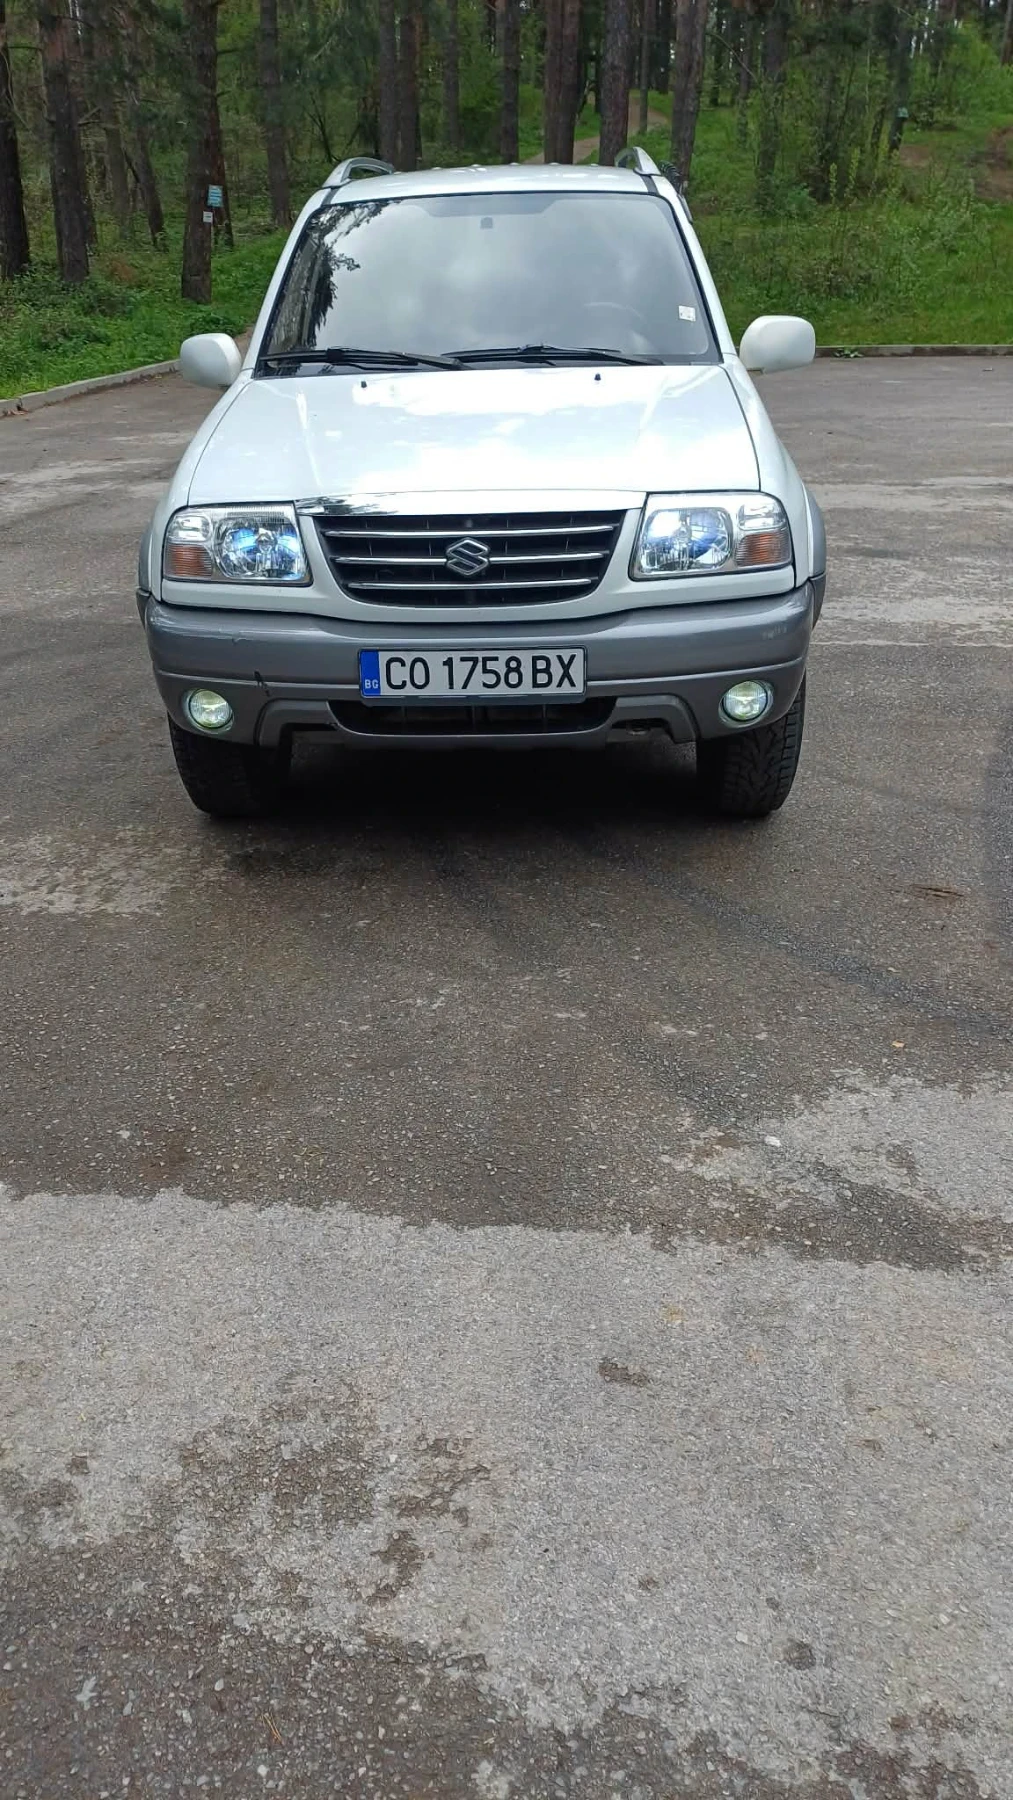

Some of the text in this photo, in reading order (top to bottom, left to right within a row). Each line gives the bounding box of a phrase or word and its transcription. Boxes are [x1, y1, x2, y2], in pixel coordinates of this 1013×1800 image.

[385, 654, 576, 690] CO 1758 BX
[364, 679, 379, 690] BG
